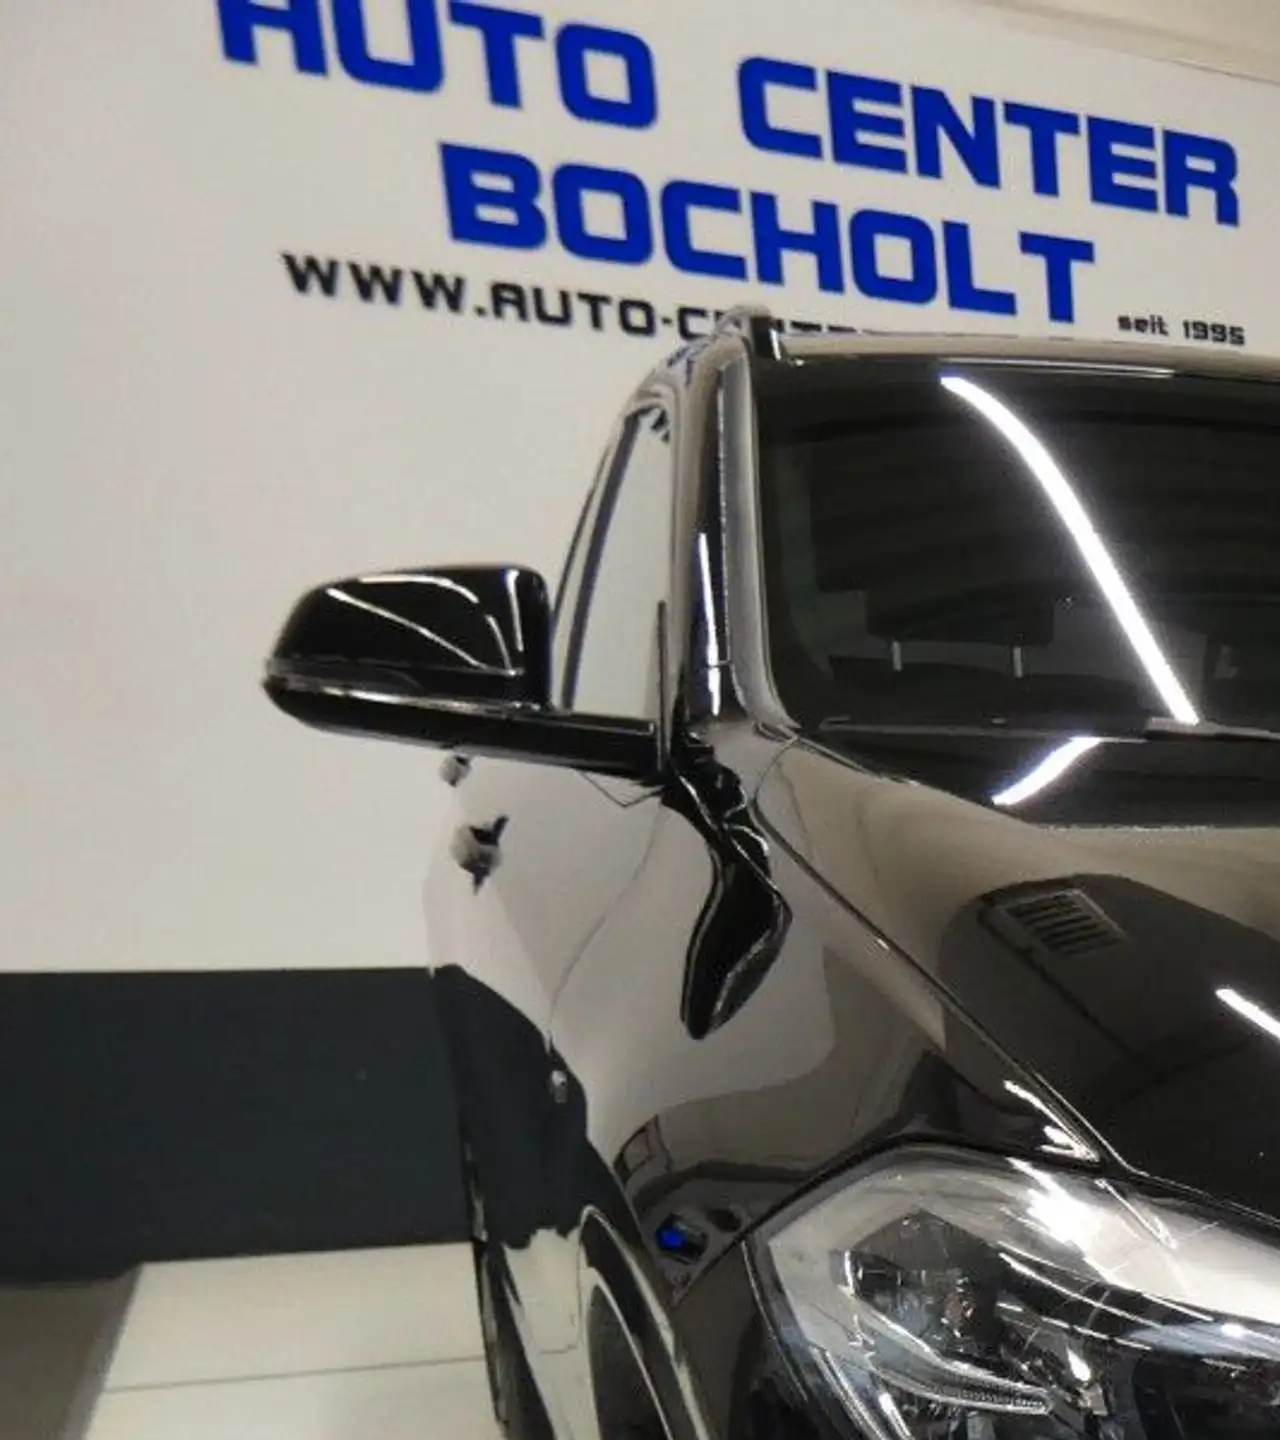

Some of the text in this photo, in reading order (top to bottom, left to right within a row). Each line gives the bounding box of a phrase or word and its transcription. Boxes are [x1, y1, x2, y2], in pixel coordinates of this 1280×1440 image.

[215, 0, 1241, 228] AUTO CENTER
[439, 141, 1097, 325] BOCHOLT
[1117, 315, 1246, 346] seit 1995
